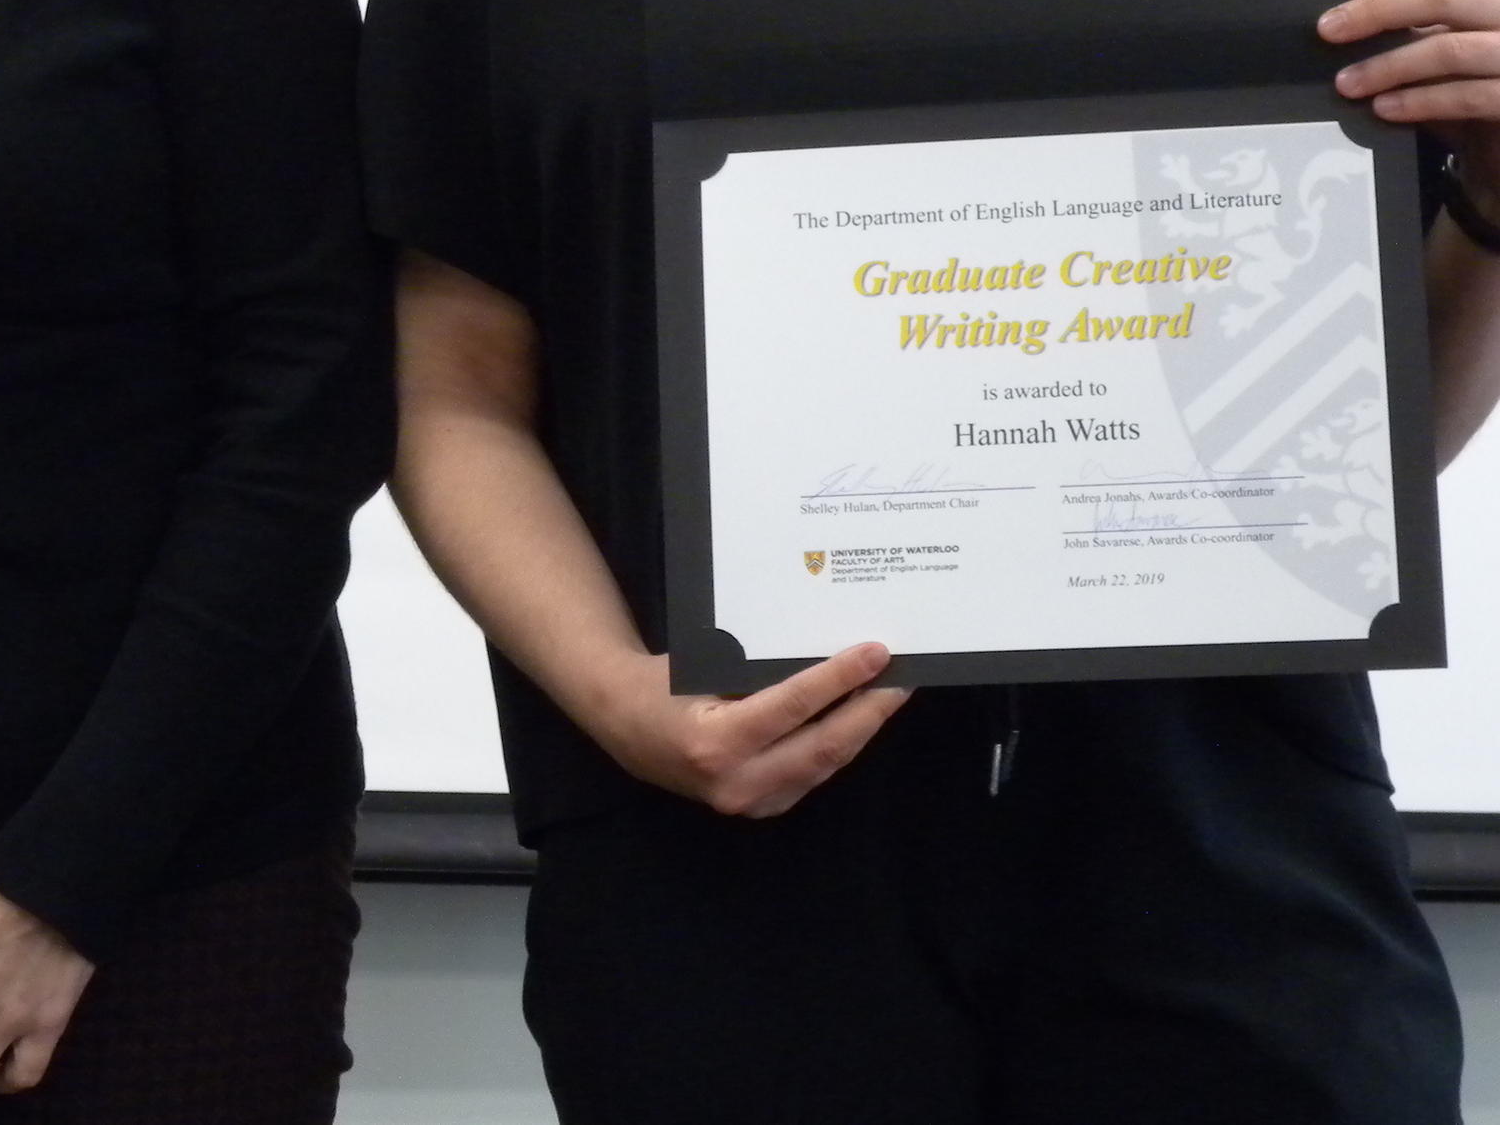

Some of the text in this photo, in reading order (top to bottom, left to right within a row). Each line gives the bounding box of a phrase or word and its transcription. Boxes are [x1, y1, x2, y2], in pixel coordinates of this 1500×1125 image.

[793, 189, 1282, 232] The Department of English Language and Literature
[852, 245, 1233, 297] Graduate Creative
[898, 301, 1196, 358] Writing Award
[982, 379, 1107, 401] is awarded to
[954, 416, 1141, 447] Hannah Watts
[1060, 485, 1275, 504] Andrea Jonahs, Awards Co-coordinator
[800, 498, 979, 516] Shelley Hulan, Department Chair
[1062, 530, 1274, 549] John Savarese, Awards Co-coordinator
[831, 545, 959, 557] UNIVERSITY OF WATERLOO
[831, 557, 867, 566] FACULTY
[884, 556, 905, 564] ARTS
[832, 565, 878, 575] Department
[890, 564, 917, 573] English
[920, 563, 958, 572] Language
[832, 574, 885, 583] and Literature
[1067, 574, 1107, 588] March
[1134, 572, 1165, 585] 2019
